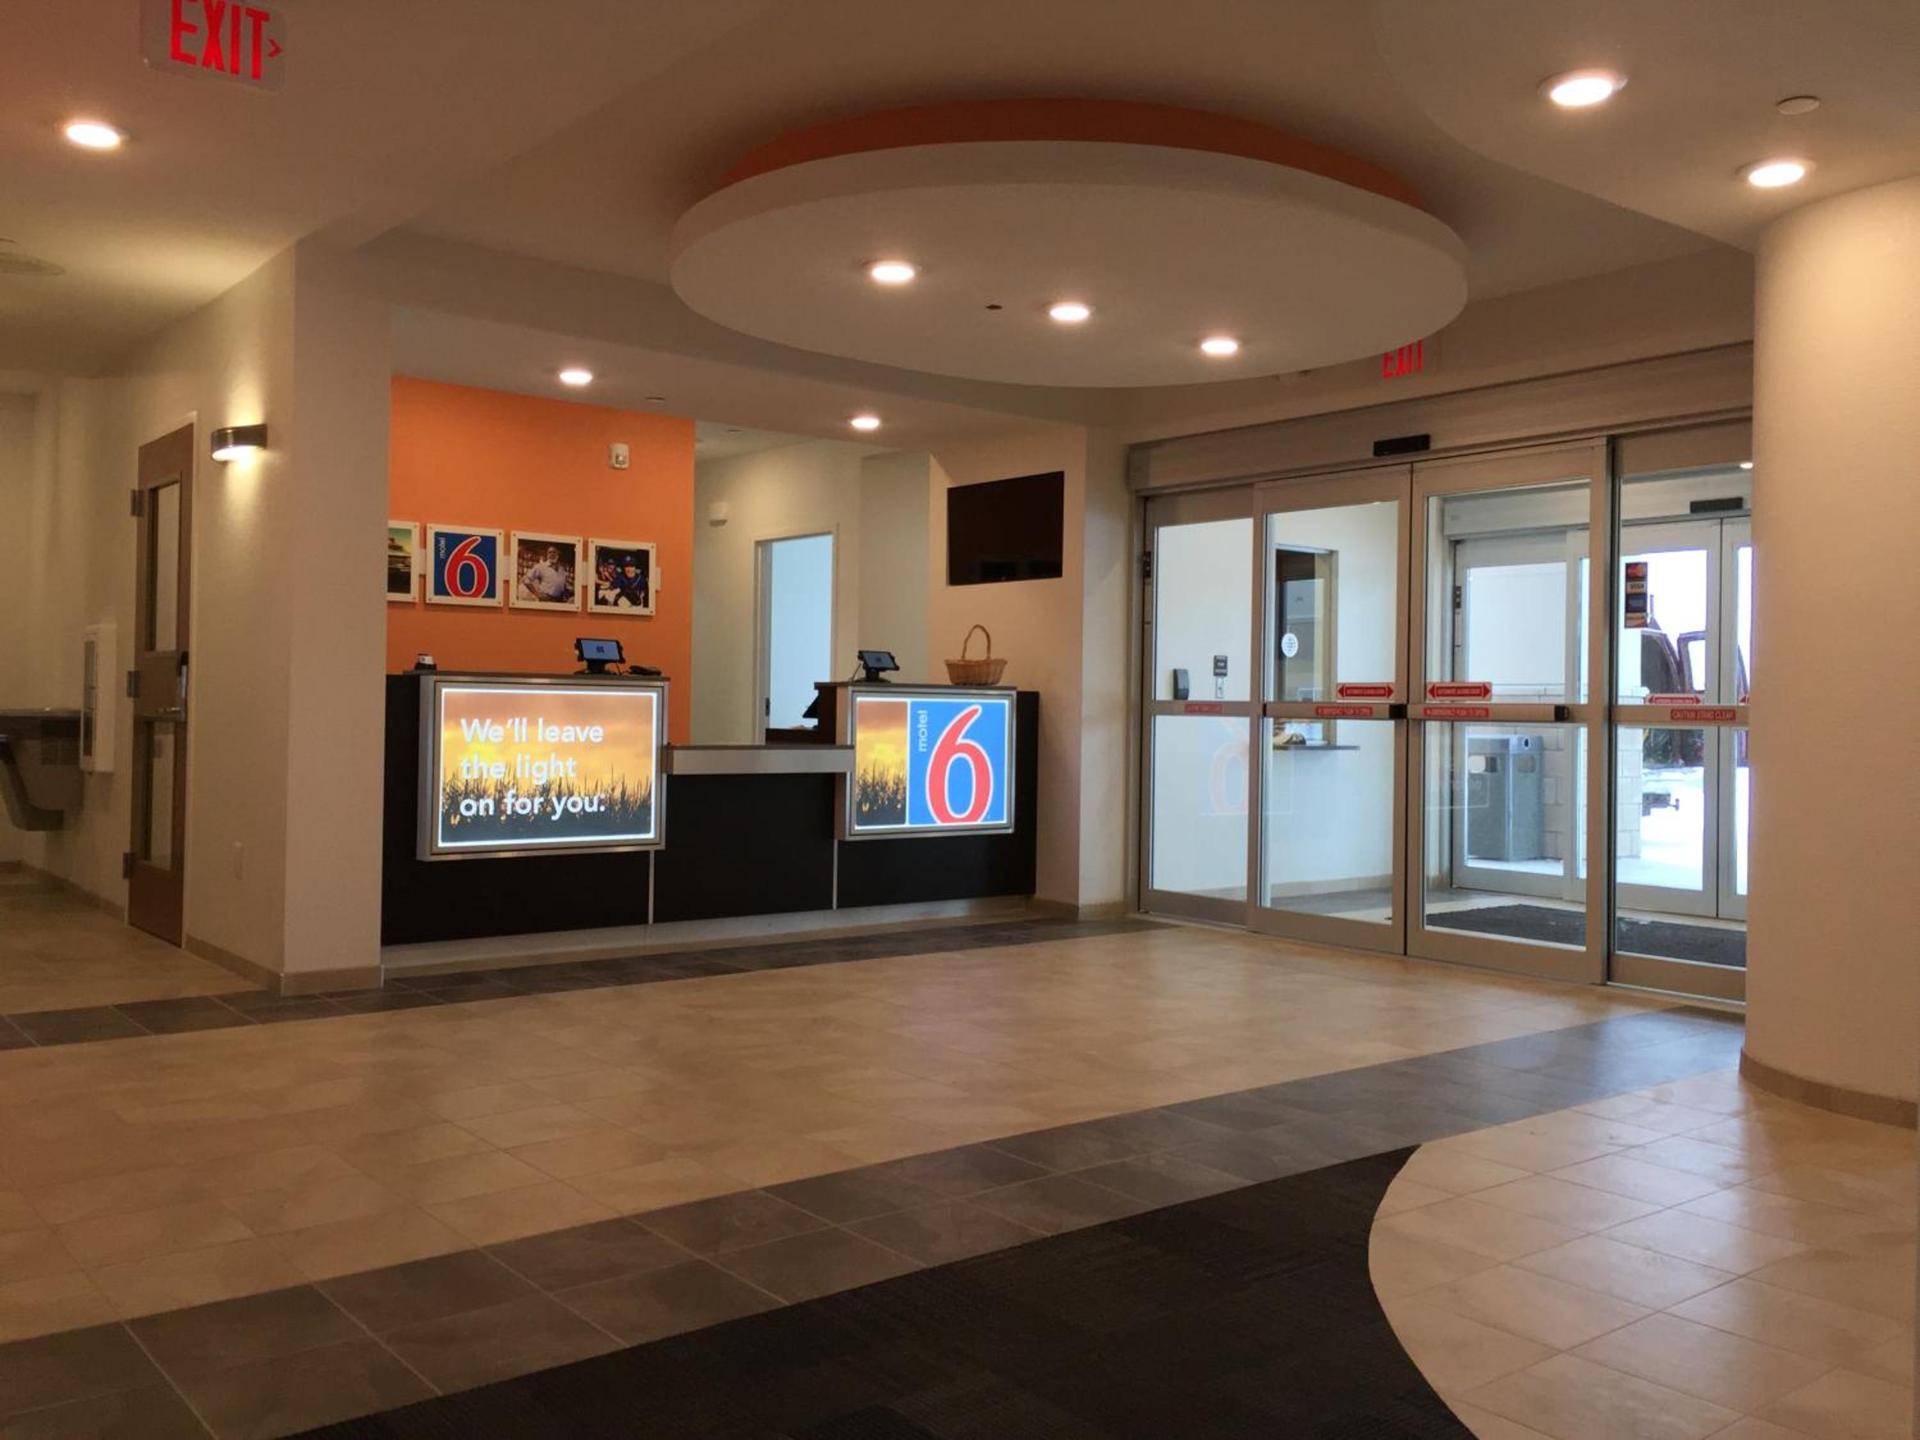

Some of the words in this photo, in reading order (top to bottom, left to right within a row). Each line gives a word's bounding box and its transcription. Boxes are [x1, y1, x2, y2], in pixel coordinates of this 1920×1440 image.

[170, 0, 271, 80] EXIT
[444, 536, 489, 599] 6
[460, 718, 528, 743] We'll
[537, 717, 604, 743] leave
[917, 709, 929, 753] motel
[460, 752, 508, 779] the
[516, 753, 577, 785] light
[925, 704, 994, 825] 6
[459, 797, 495, 817] on
[504, 789, 544, 815] for
[551, 795, 606, 821] you.
